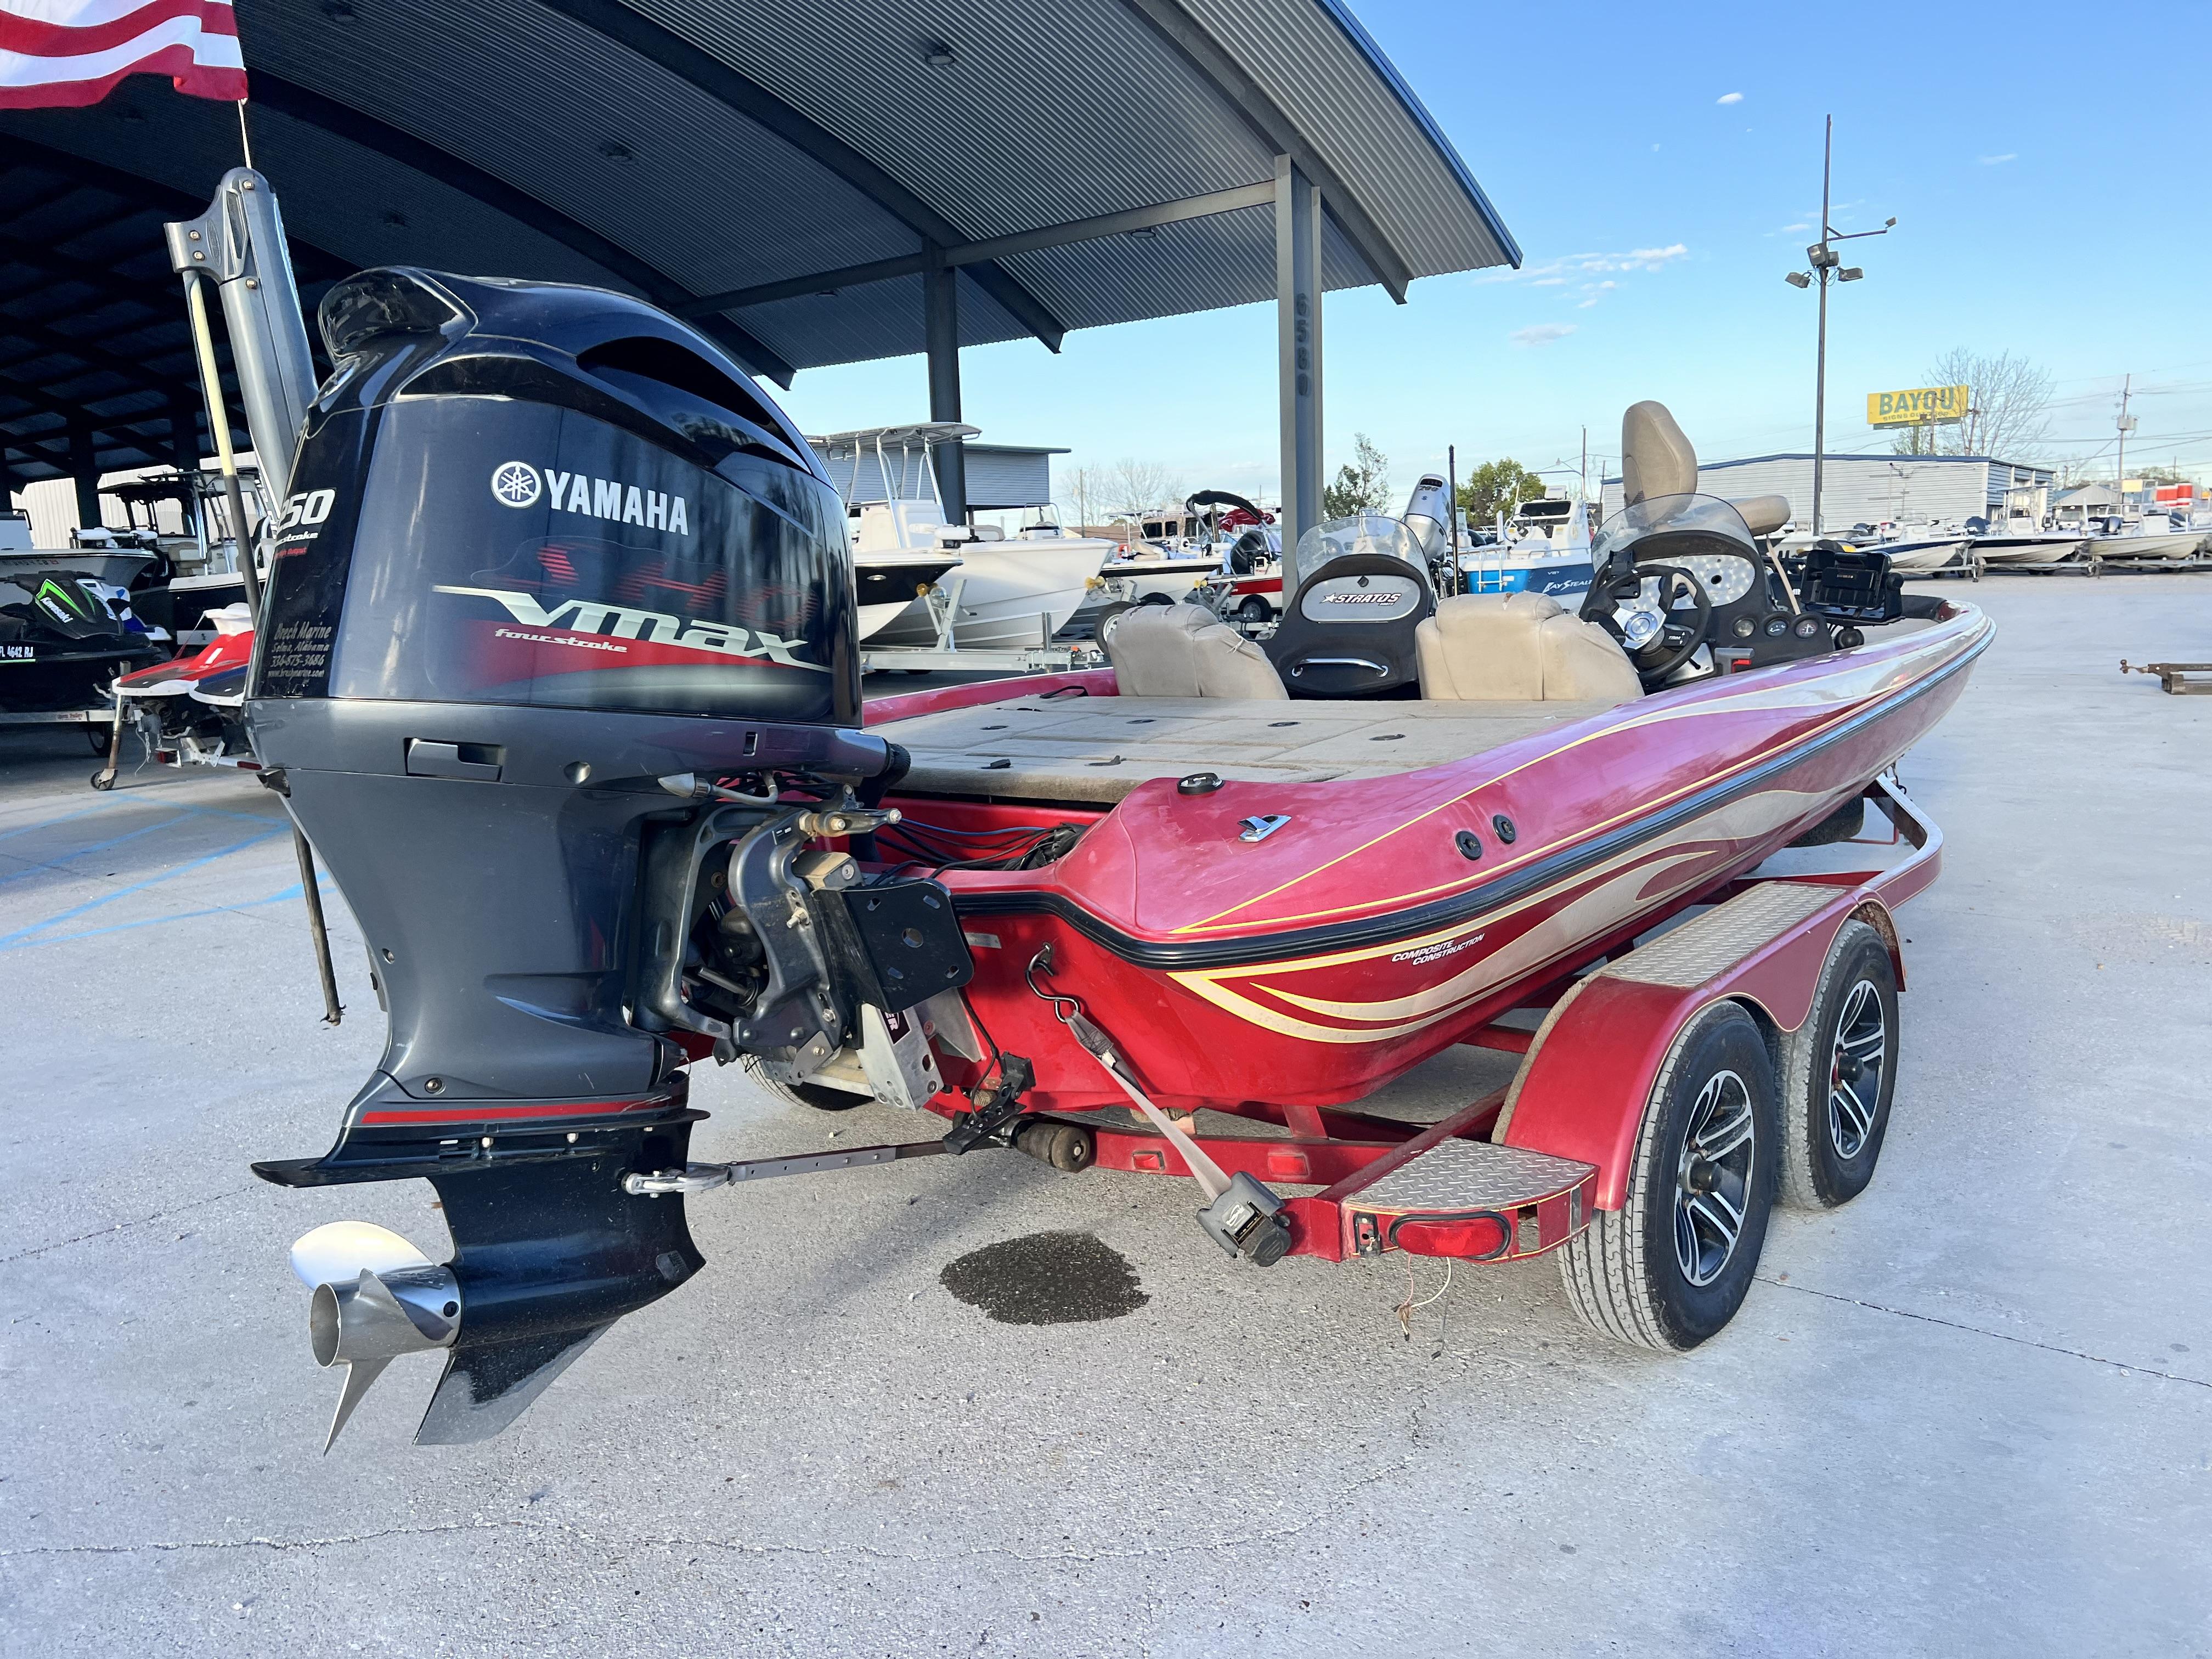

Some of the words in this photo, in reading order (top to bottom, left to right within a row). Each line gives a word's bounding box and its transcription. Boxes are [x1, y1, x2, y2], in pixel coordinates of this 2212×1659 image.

[1879, 387, 1955, 416] BAYOU
[1883, 413, 1908, 422] SIGNS
[544, 469, 689, 536] YAMAHA
[275, 531, 319, 548] stroke
[1334, 593, 1402, 604] STRATOS
[40, 596, 74, 623] Kawasaki
[297, 620, 332, 640] Marine
[294, 641, 330, 652] Alabama
[1391, 939, 1454, 962] COMPOSITE
[1412, 933, 1485, 966] CONSTRUCTION
